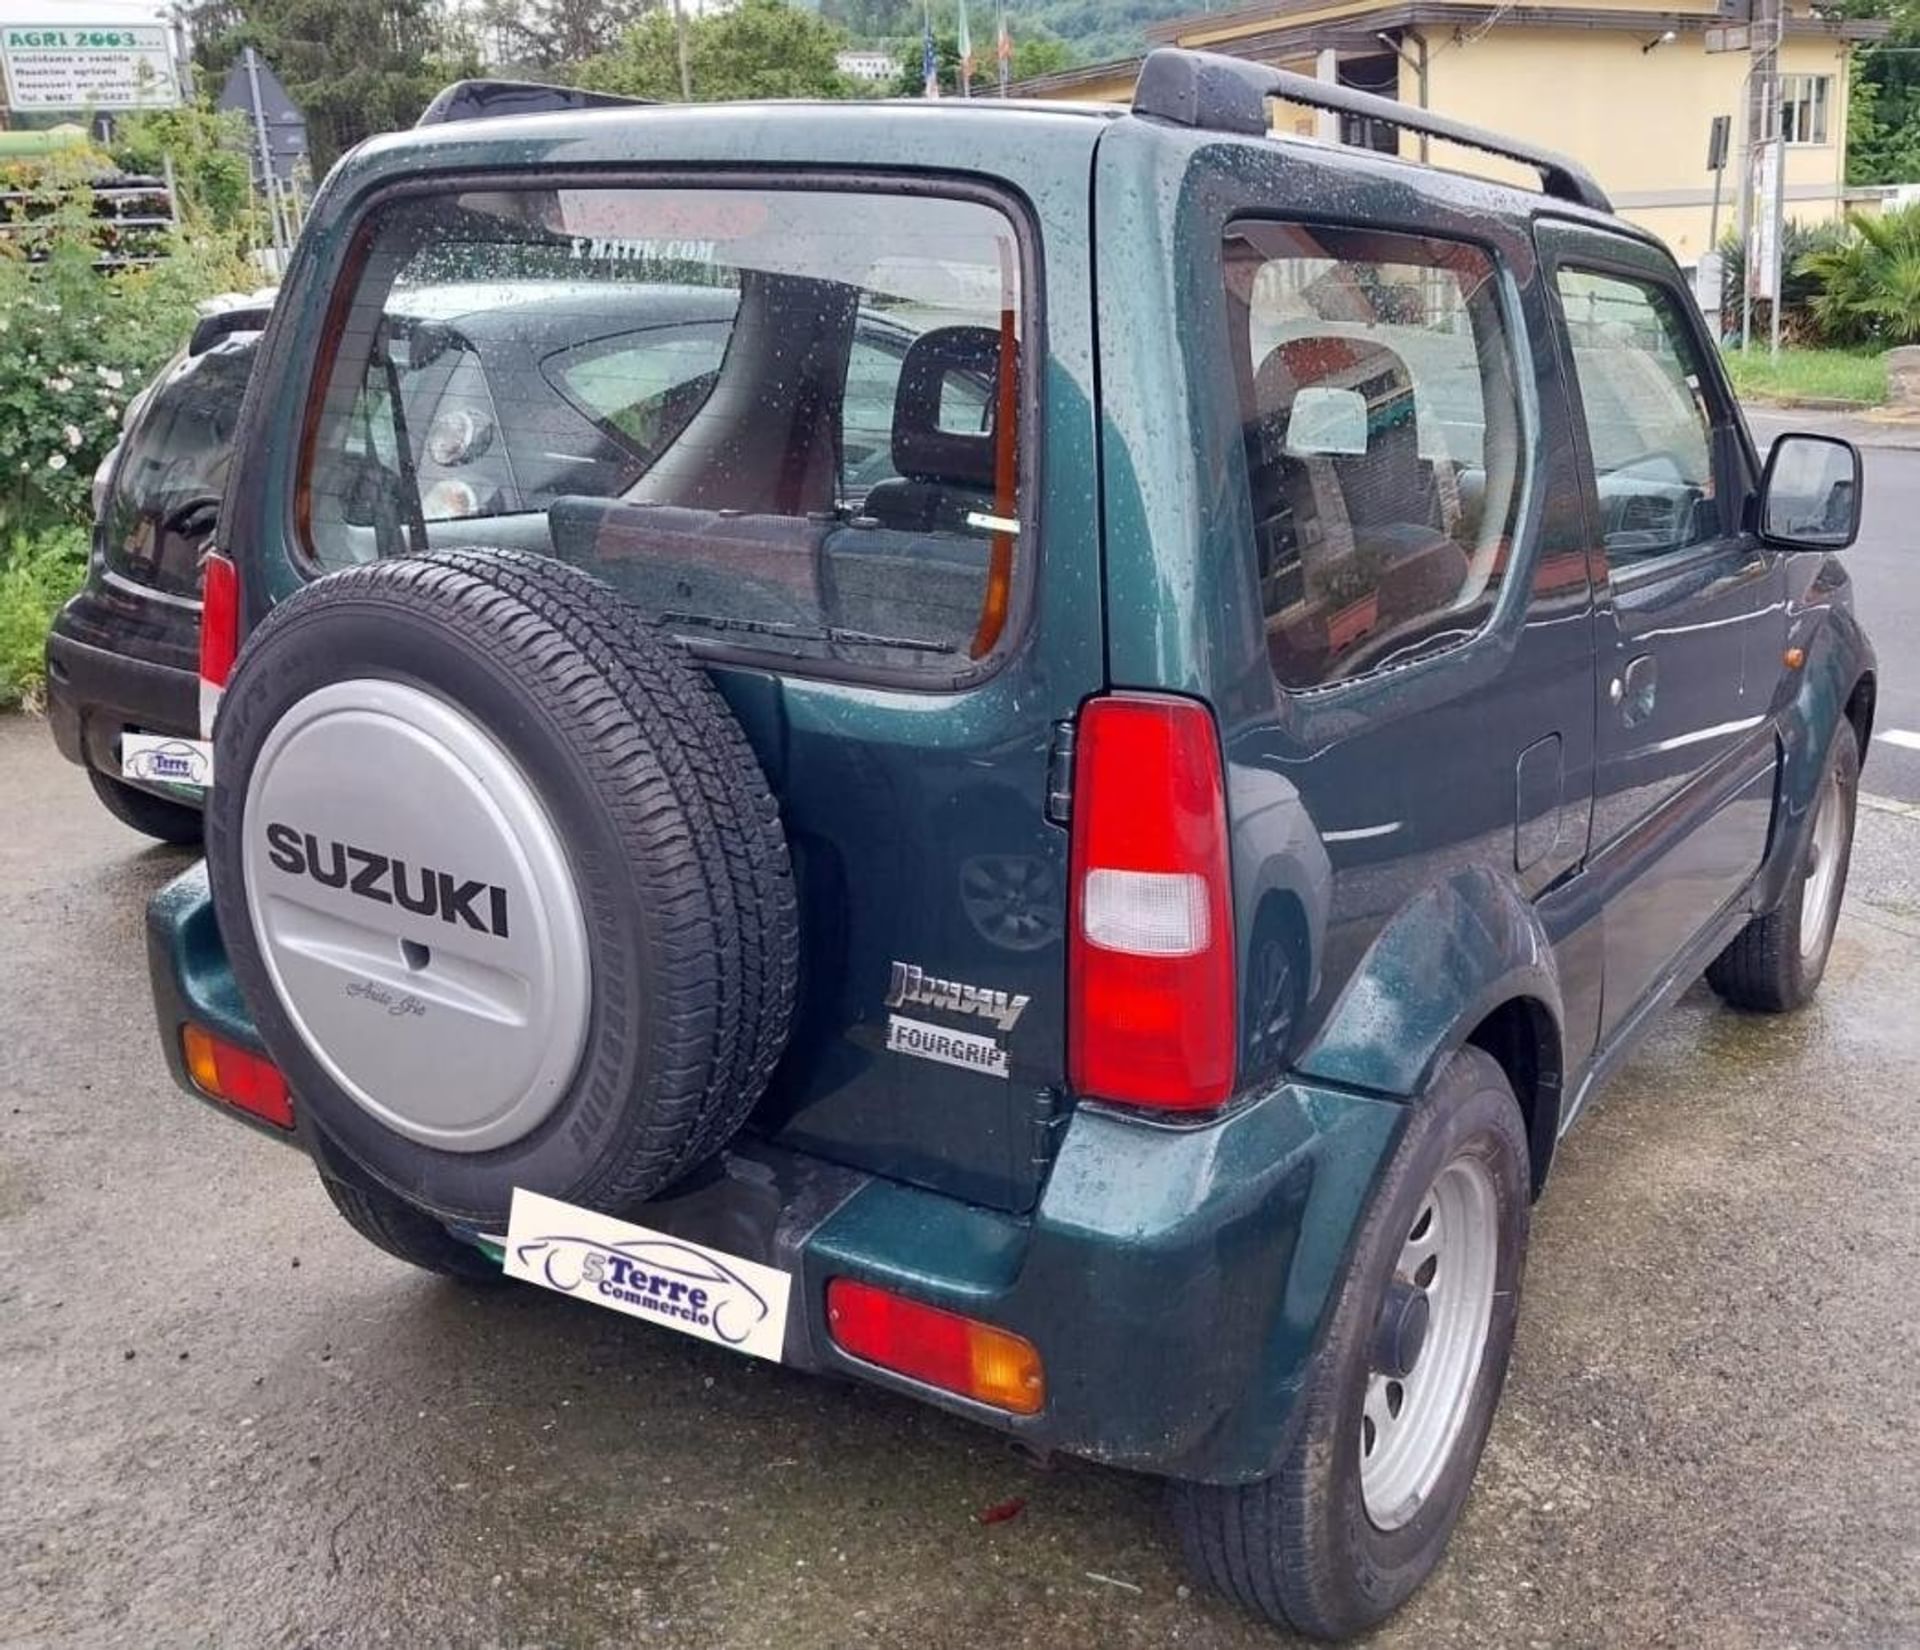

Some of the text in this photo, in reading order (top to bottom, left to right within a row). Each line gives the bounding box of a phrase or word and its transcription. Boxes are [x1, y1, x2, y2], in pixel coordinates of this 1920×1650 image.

[9, 31, 68, 47] AGRI
[75, 31, 136, 47] 2003
[266, 822, 509, 938] SUZUKI
[895, 1024, 1002, 1067] FOURGRIP
[599, 1280, 710, 1325] Commercio
